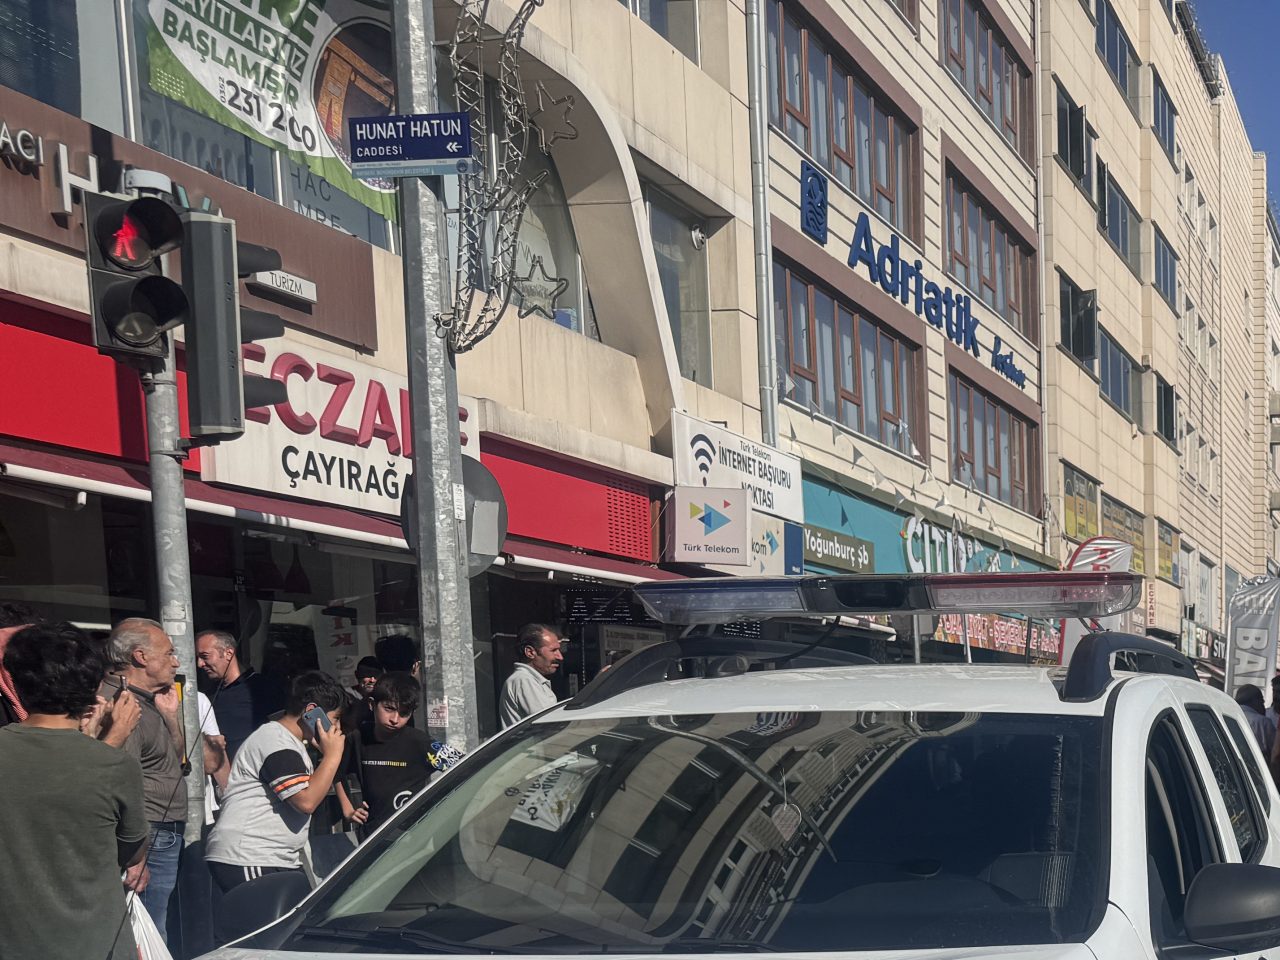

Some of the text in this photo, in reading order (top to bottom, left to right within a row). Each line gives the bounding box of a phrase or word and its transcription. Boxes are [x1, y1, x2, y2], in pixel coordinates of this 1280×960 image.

[226, 80, 262, 122] 231
[356, 118, 462, 141] HUNAT HATUN
[356, 144, 403, 157] CADDESİ
[269, 271, 303, 295] TURİZM
[847, 211, 980, 358] Adriatik
[718, 441, 791, 489] İNTERNET BAŞVURU
[740, 440, 771, 462] Türk Telekom
[281, 445, 413, 500] ÇAYIRAĞ
[741, 481, 774, 509] KTASI
[683, 543, 740, 554] Türk Telekom
[803, 528, 855, 568] Yoğunburç
